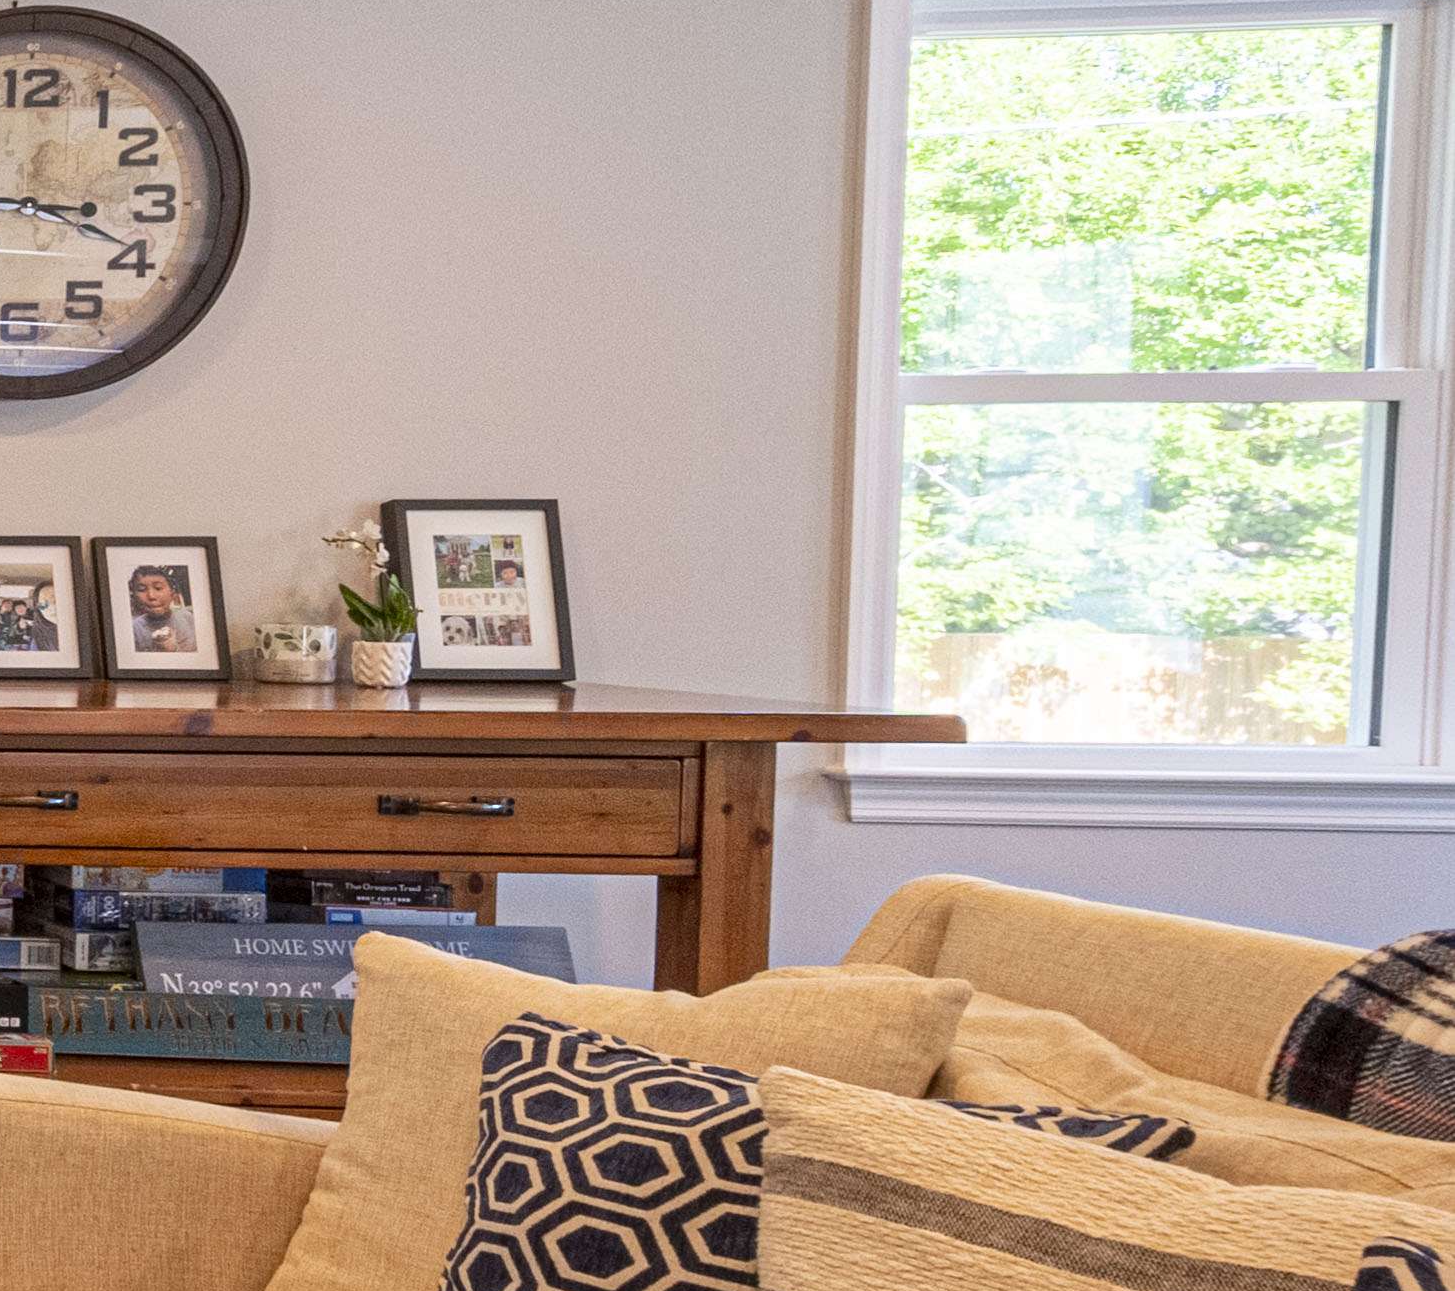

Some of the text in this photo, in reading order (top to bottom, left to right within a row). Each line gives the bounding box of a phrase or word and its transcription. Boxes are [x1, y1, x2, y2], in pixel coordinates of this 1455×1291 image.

[3, 68, 60, 109] 12
[97, 90, 111, 129] 1
[118, 127, 160, 168] 2
[133, 183, 177, 224] 3
[107, 239, 156, 279] 4
[64, 280, 104, 320] 5
[0, 302, 40, 343] 6
[233, 938, 307, 956] HOME
[159, 972, 183, 994] N
